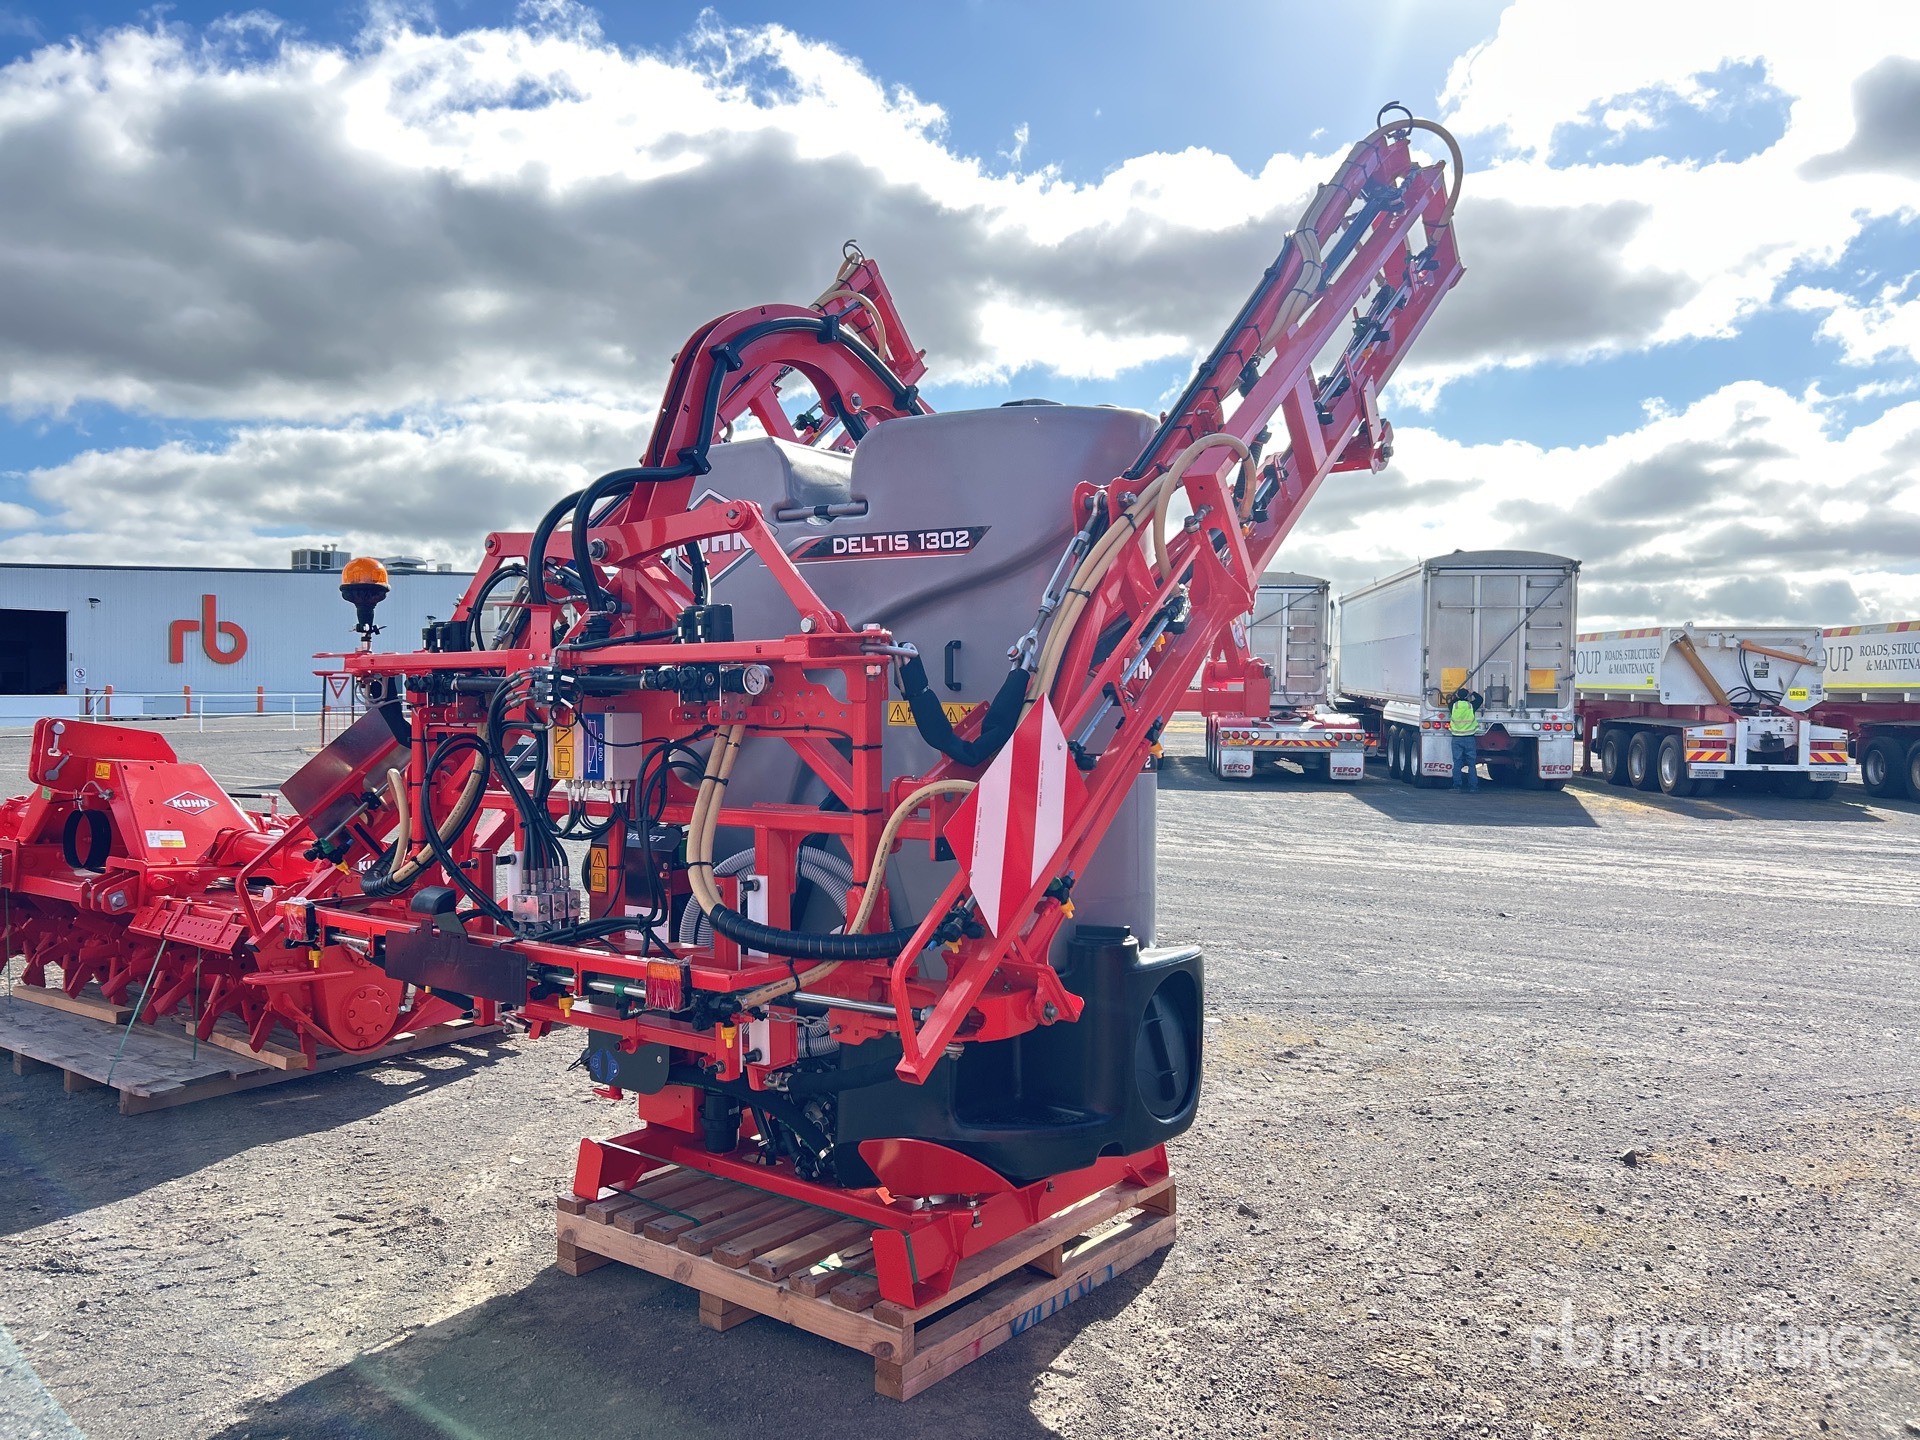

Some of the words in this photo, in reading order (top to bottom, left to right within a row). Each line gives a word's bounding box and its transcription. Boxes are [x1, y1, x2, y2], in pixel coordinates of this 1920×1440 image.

[832, 534, 909, 554] DELTIS
[917, 530, 970, 550] 1302
[169, 594, 248, 665] rb
[1604, 649, 1624, 661] ROADS,
[1624, 647, 1660, 661] STRUCTURES
[1859, 644, 1890, 657] ROADS,
[1608, 663, 1614, 675] &
[1614, 662, 1655, 675] MAINTENANCE
[1223, 763, 1251, 771] TEFCO
[1424, 762, 1453, 770] TEFCO
[1541, 764, 1571, 772] TEFCO
[172, 799, 210, 809] KUHN
